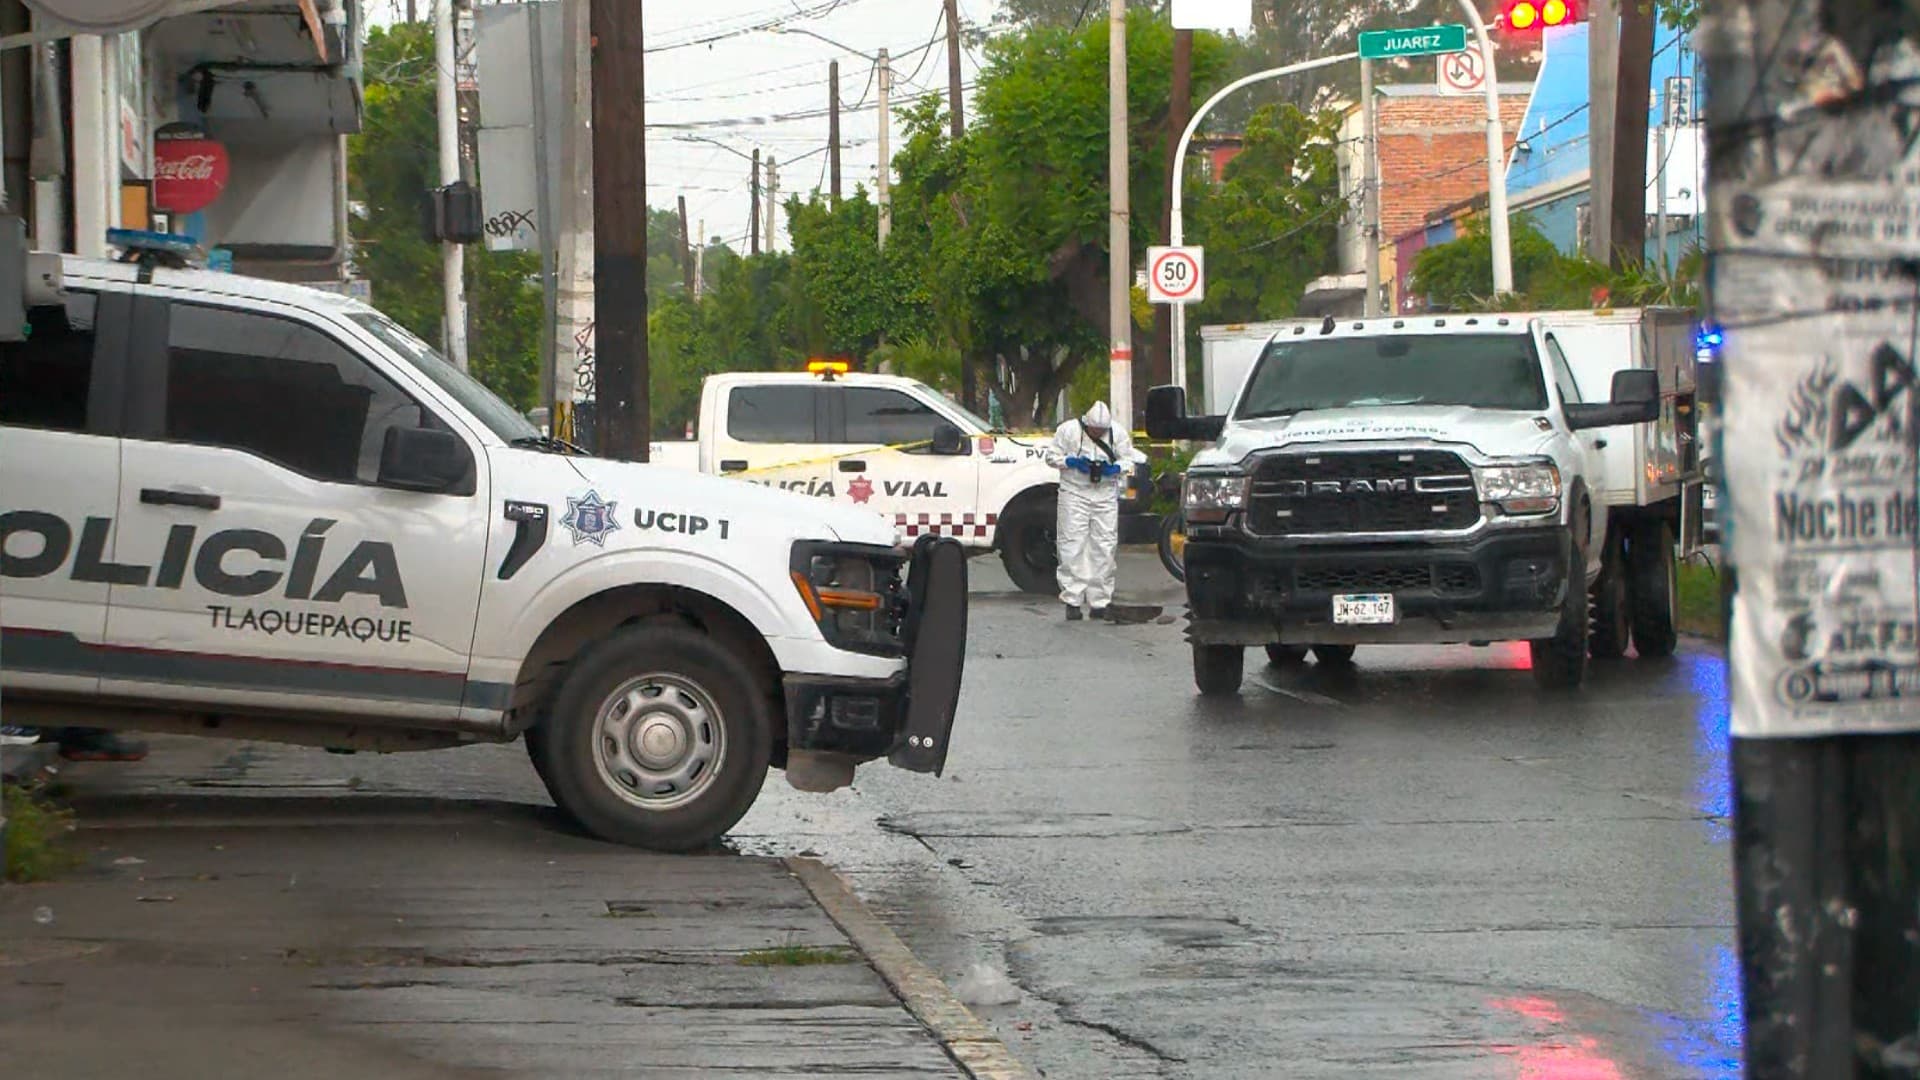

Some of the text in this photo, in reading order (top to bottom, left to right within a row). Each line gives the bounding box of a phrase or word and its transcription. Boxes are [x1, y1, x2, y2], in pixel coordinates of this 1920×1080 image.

[1384, 35, 1441, 51] JUAREZ
[1164, 261, 1186, 280] 50
[883, 480, 949, 498] VIAL
[1312, 478, 1408, 494] RAM
[633, 508, 729, 540] UCIP 1
[1775, 490, 1876, 542] Noche
[0, 510, 409, 609] OLICÍA
[207, 605, 412, 642] TLAQUEPAQUE
